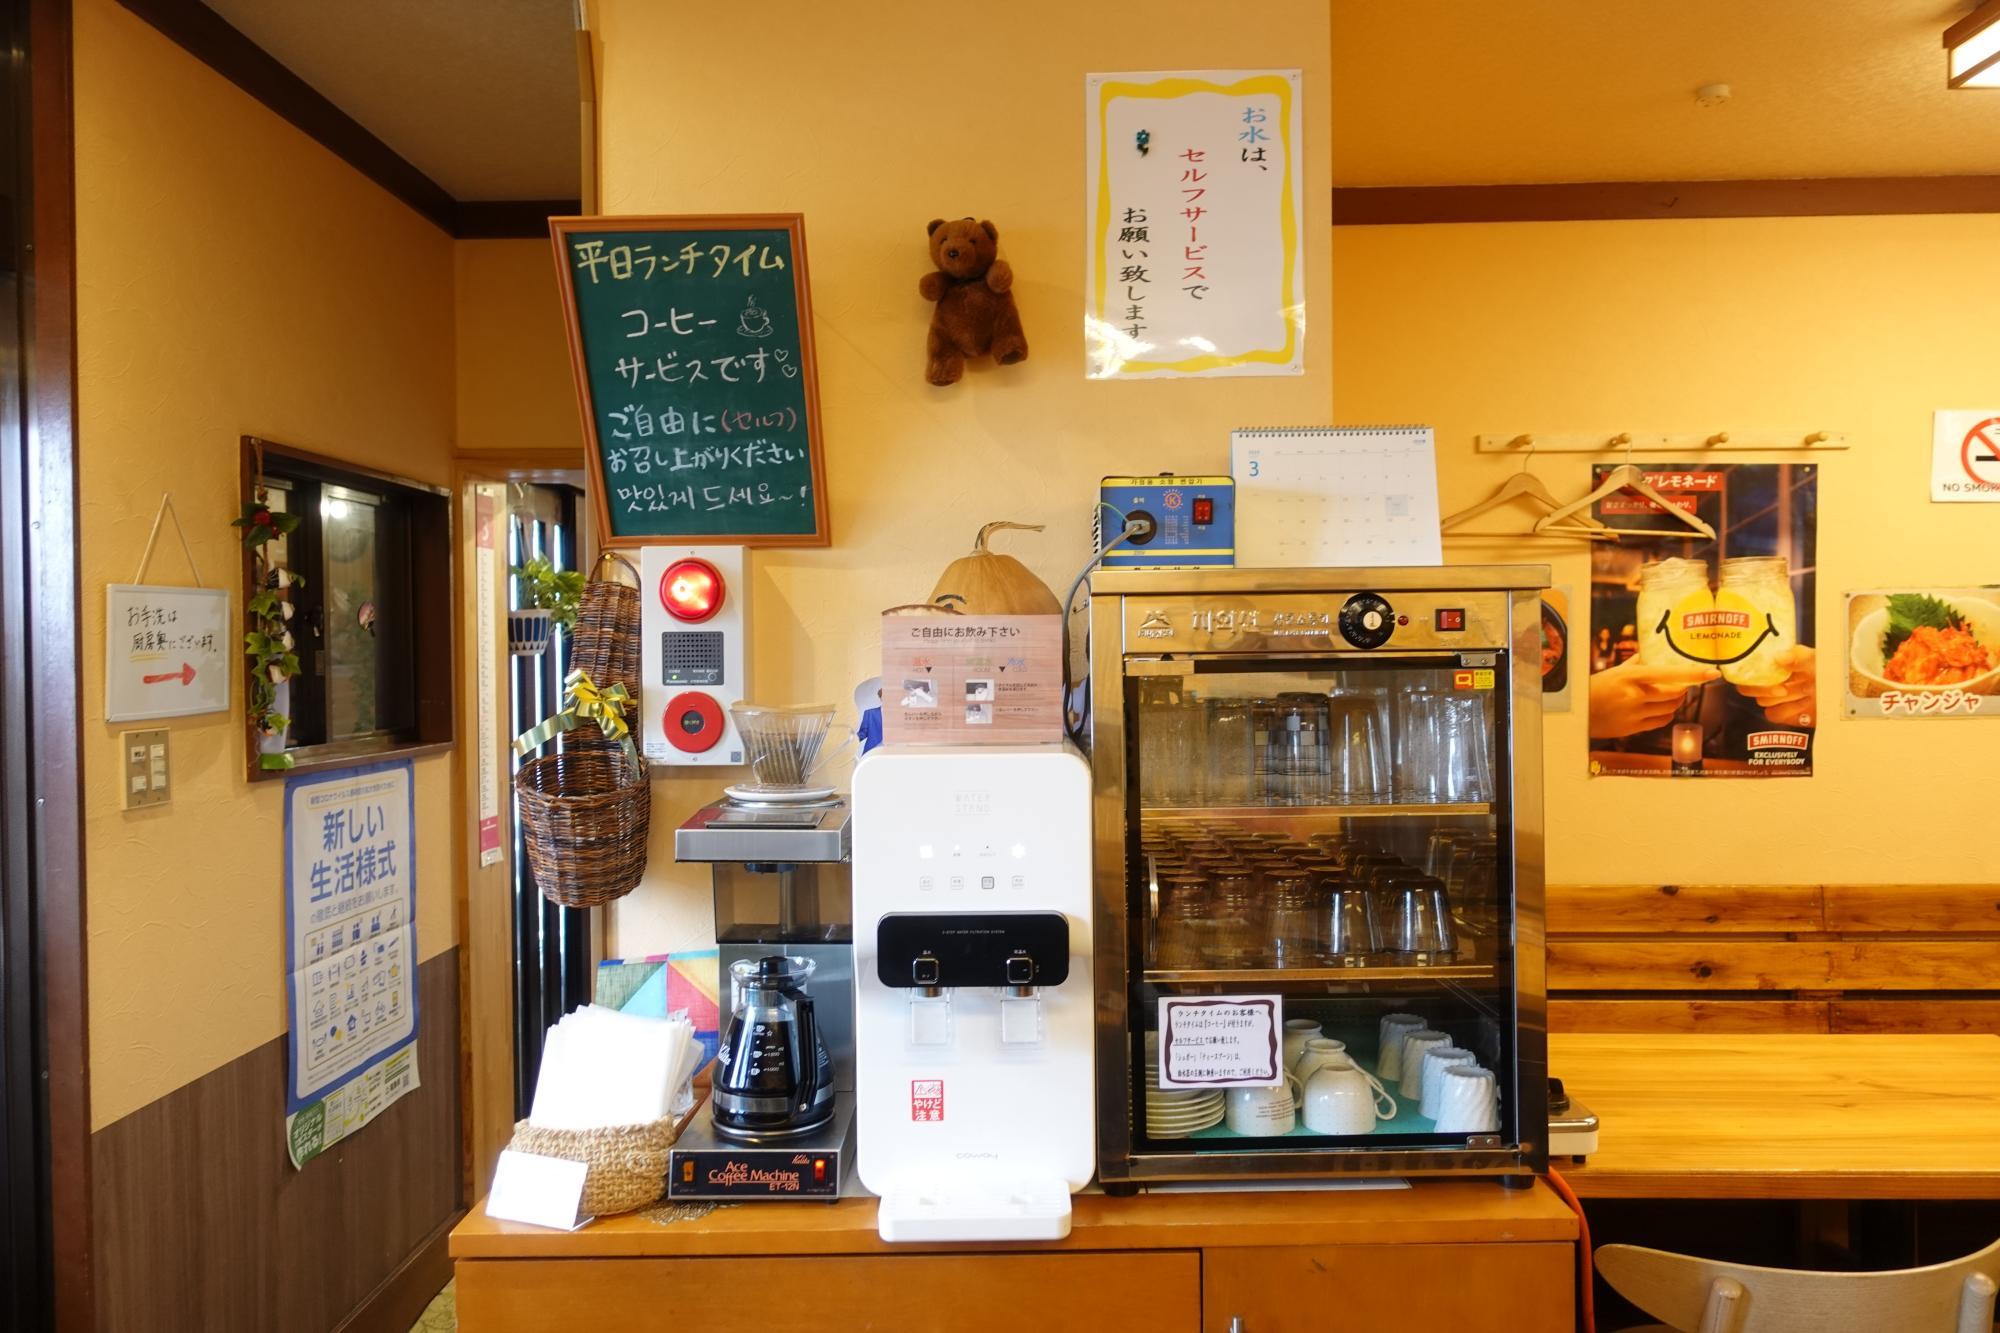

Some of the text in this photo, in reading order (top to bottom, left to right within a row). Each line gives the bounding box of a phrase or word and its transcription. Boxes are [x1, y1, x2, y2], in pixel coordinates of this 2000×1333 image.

[1238, 106, 1271, 171] お水は、
[1179, 148, 1209, 300] セルフサービスで
[574, 240, 785, 284] 平日ランチタイム
[1118, 207, 1151, 339] お願い致します
[621, 307, 718, 338] コーヒー
[614, 346, 770, 389] サービスです
[608, 404, 717, 440] ご自由に
[607, 438, 805, 474] お召し上がりください
[1248, 460, 1260, 477] 3
[1943, 482, 1961, 493] NO
[617, 483, 695, 513] 맛있게
[127, 605, 178, 628] お手洗は
[1685, 612, 1747, 627] SMIRNOFF
[911, 626, 1021, 638] ご自由にお飲み下さい
[1689, 632, 1743, 641] LEMONADE
[1881, 692, 1980, 712] チャンジャ
[1752, 735, 1804, 748] SMIRNOFF
[1748, 758, 1805, 766] FOR EVERYBODY
[1754, 751, 1799, 759] EXCLUSIVELY
[323, 806, 384, 852] 新しい
[309, 839, 397, 904] 生活様式
[1178, 1008, 1262, 1017] ランチタイムのお客様へ
[912, 1098, 942, 1109] やけど
[915, 1110, 941, 1121] 注意
[725, 1161, 748, 1172] Ace
[708, 1169, 799, 1187] Coffee Machine
